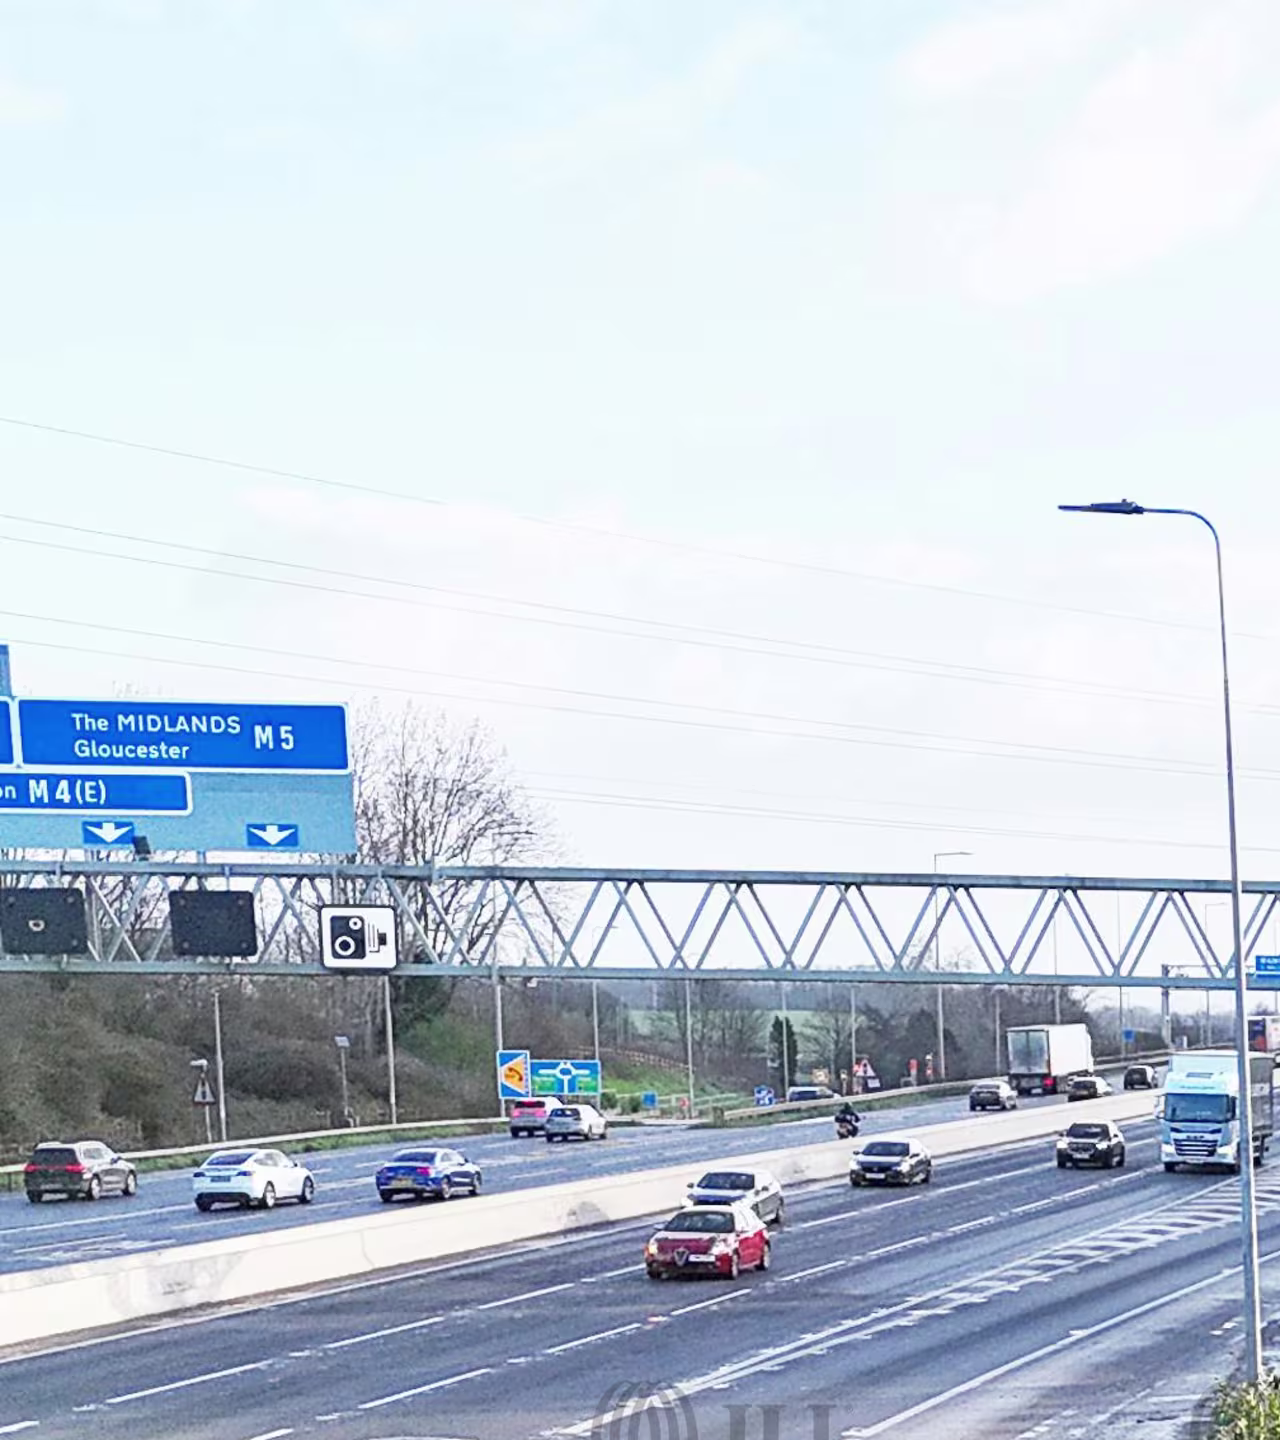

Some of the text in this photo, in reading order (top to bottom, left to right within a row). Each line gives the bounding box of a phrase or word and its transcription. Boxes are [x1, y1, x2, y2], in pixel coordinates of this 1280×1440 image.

[71, 713, 241, 734] The MIDLANDS
[74, 740, 190, 759] Gloucester
